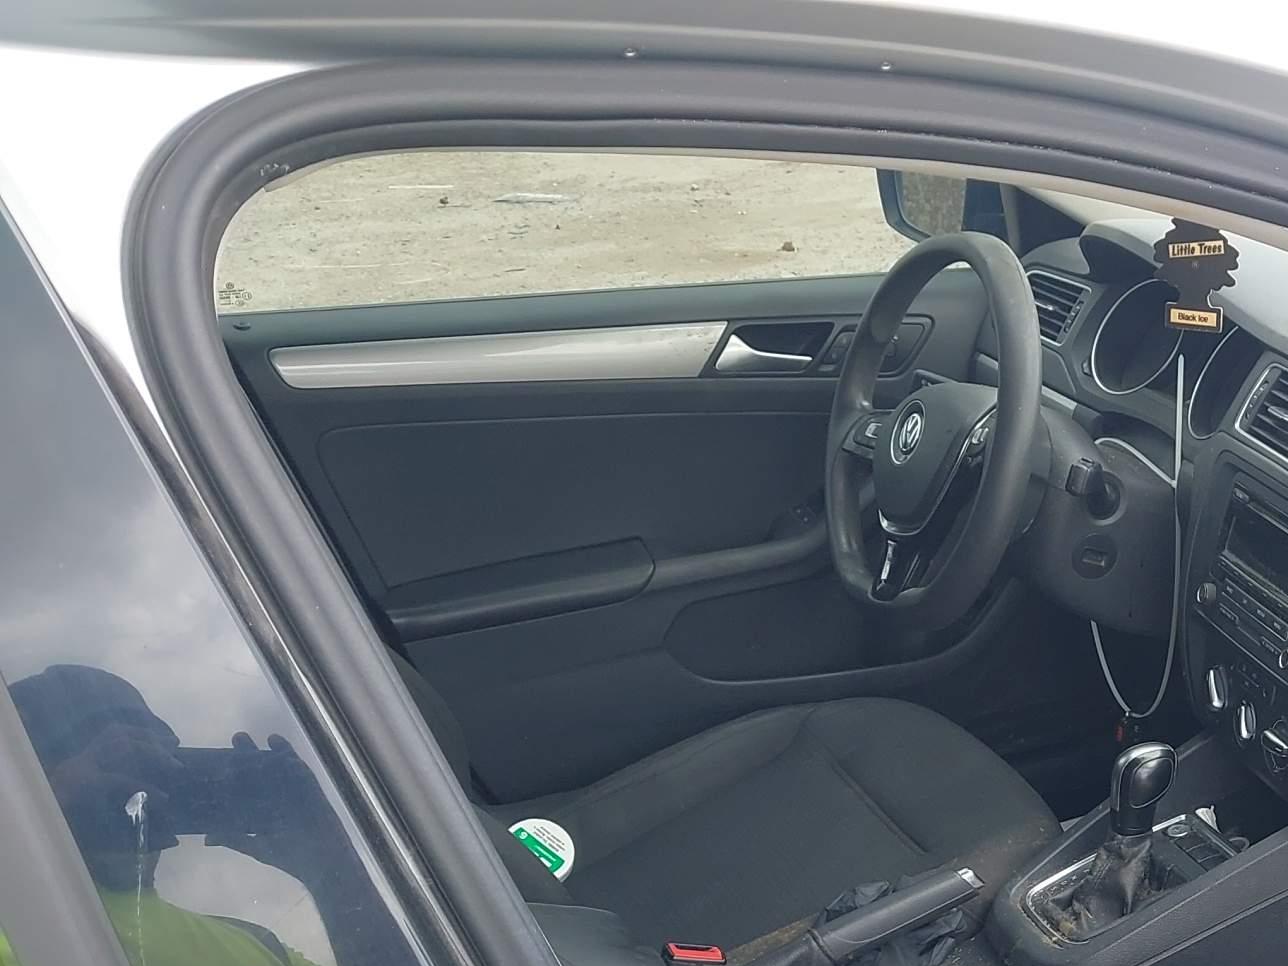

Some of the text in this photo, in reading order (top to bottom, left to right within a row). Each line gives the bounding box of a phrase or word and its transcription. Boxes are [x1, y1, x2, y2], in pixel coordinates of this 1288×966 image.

[1171, 242, 1222, 257] Little Trees
[1177, 312, 1209, 323] Black Ice
